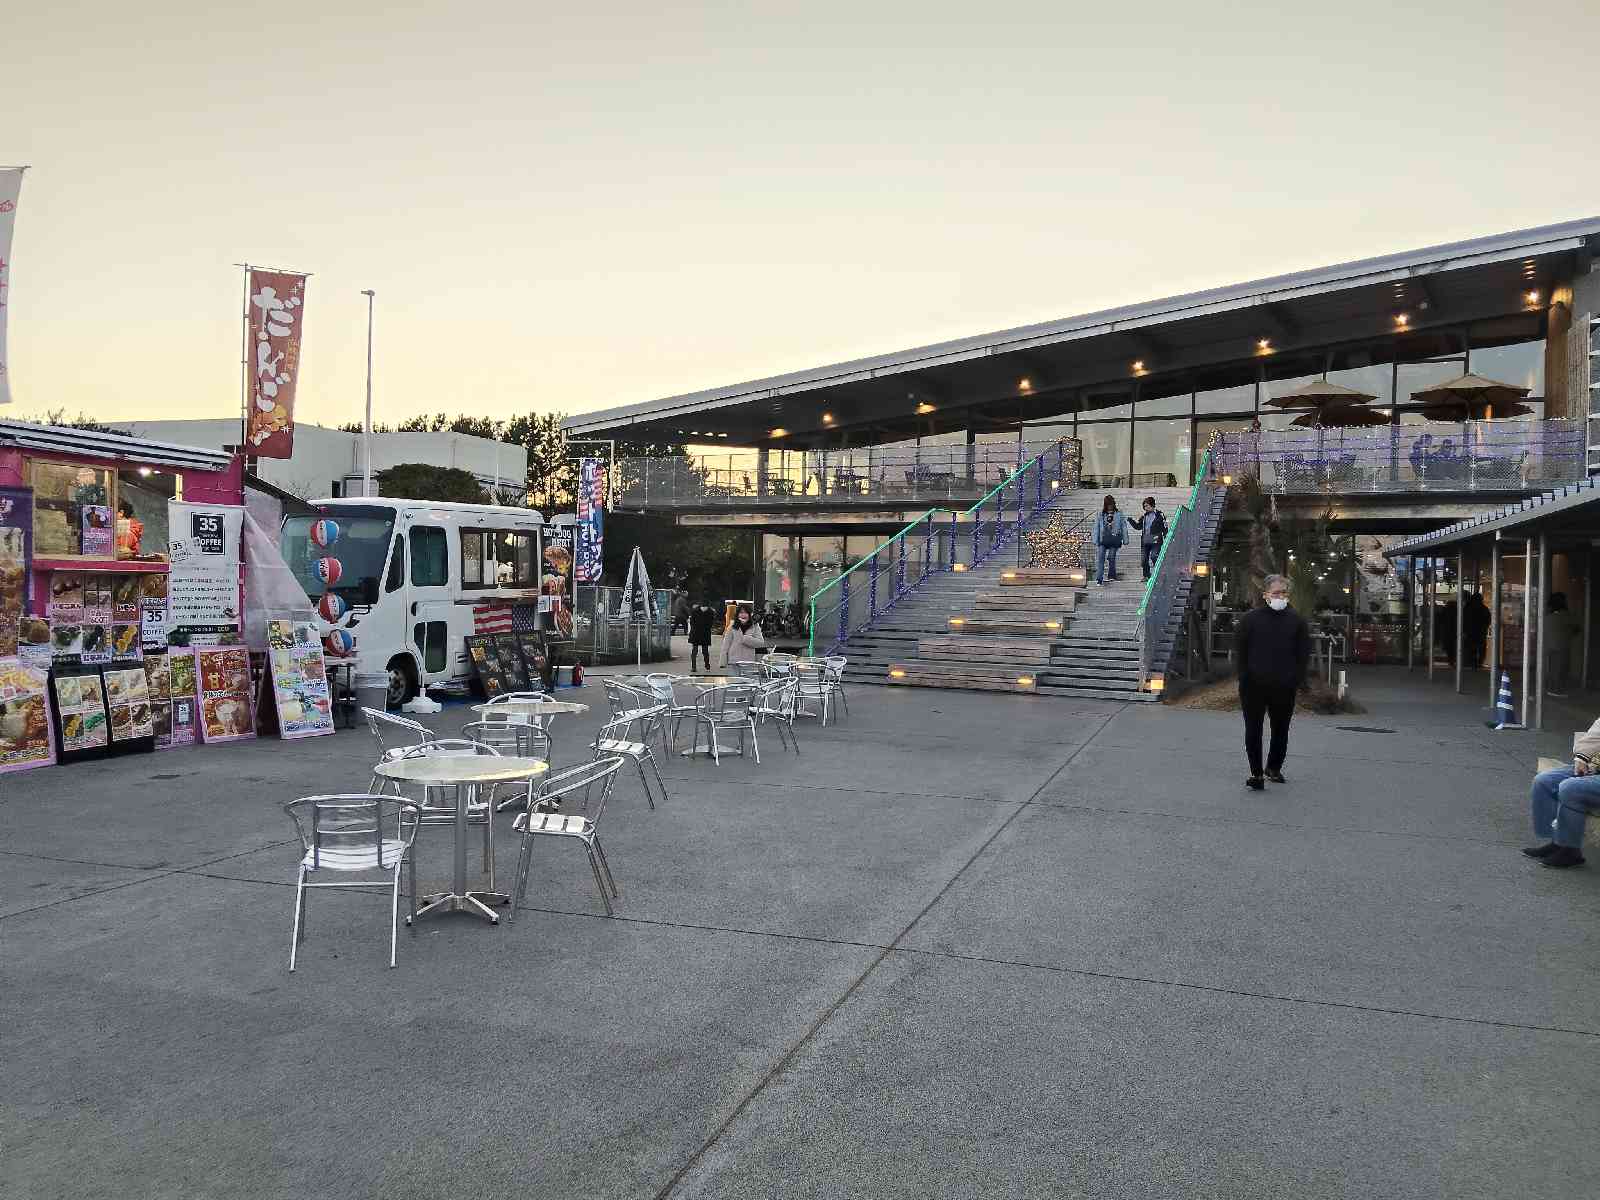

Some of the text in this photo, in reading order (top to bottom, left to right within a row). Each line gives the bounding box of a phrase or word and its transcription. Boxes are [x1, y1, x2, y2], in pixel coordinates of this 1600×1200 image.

[252, 286, 301, 412] だんご
[199, 517, 218, 532] 35
[147, 611, 162, 623] 35
